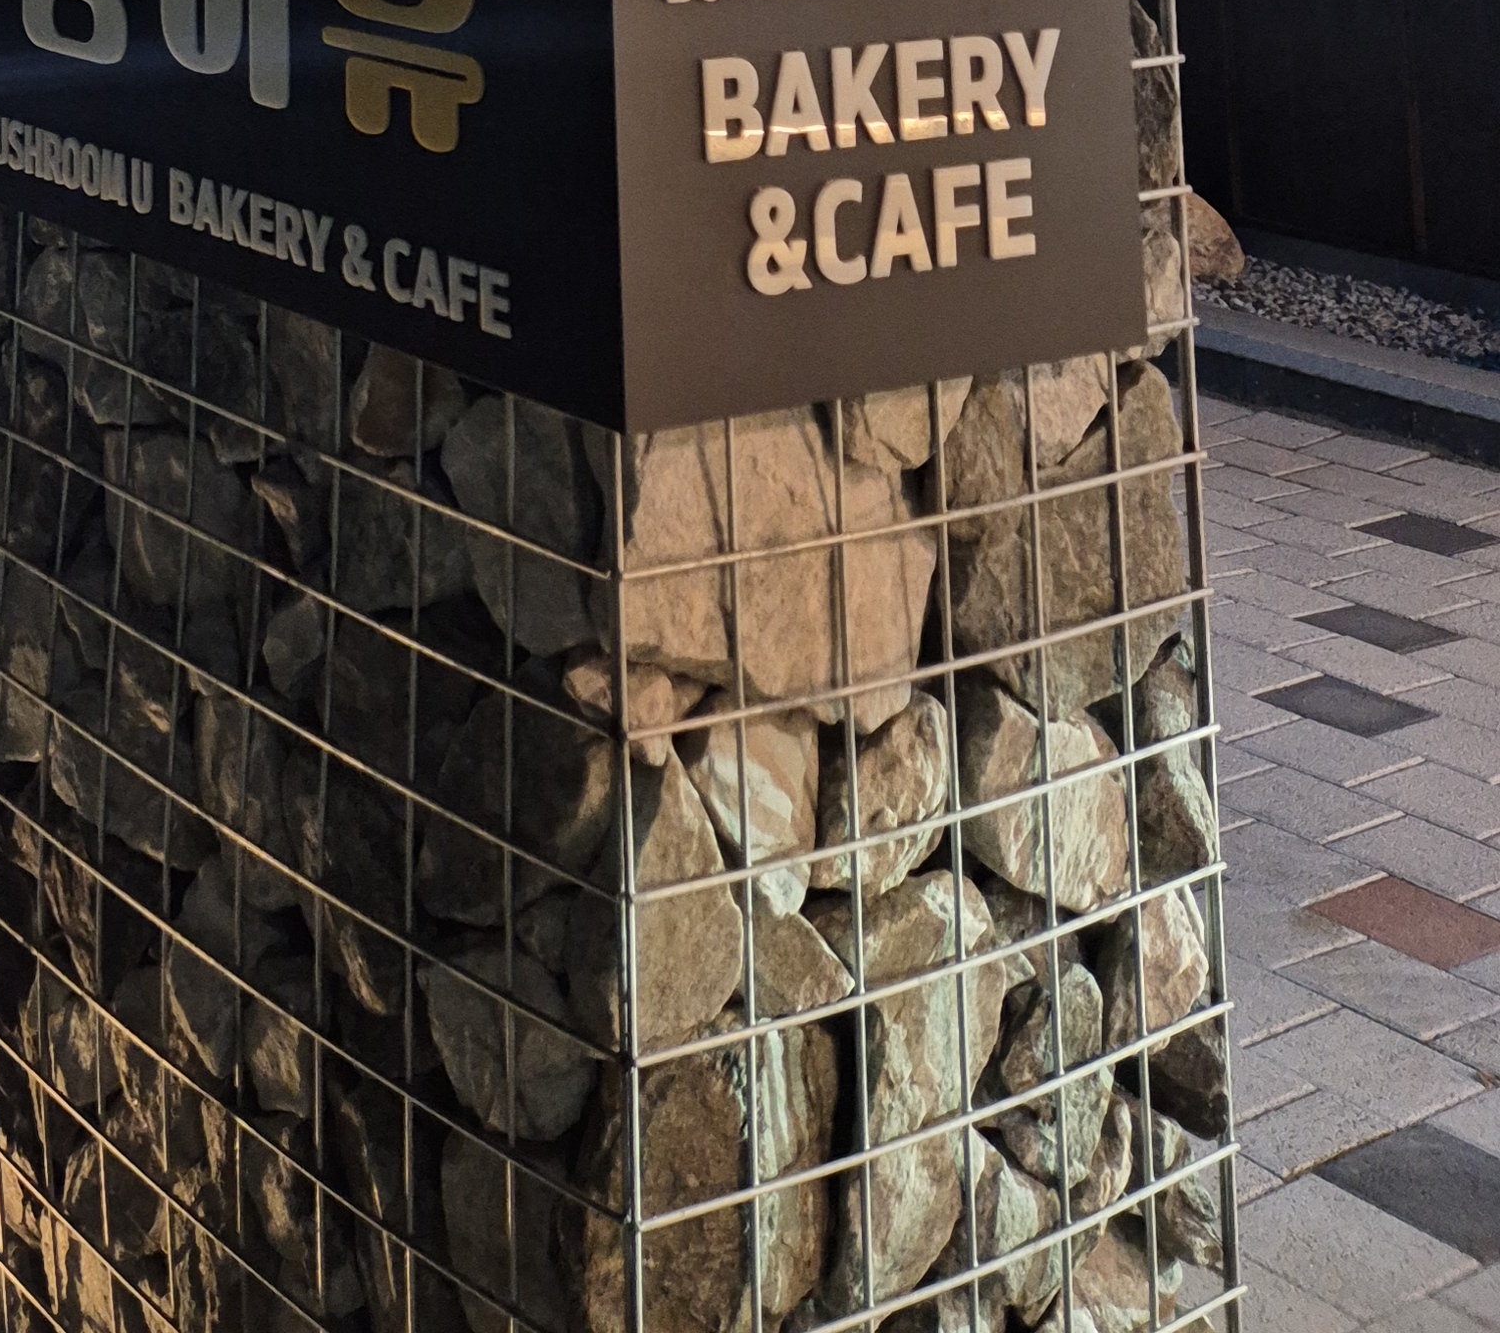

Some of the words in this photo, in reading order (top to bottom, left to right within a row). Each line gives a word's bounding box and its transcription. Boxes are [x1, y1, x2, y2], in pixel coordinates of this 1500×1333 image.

[702, 28, 1061, 164] BAKERY
[131, 157, 154, 215] U
[169, 166, 334, 273] BAKERY
[746, 157, 1037, 297] &CAFE
